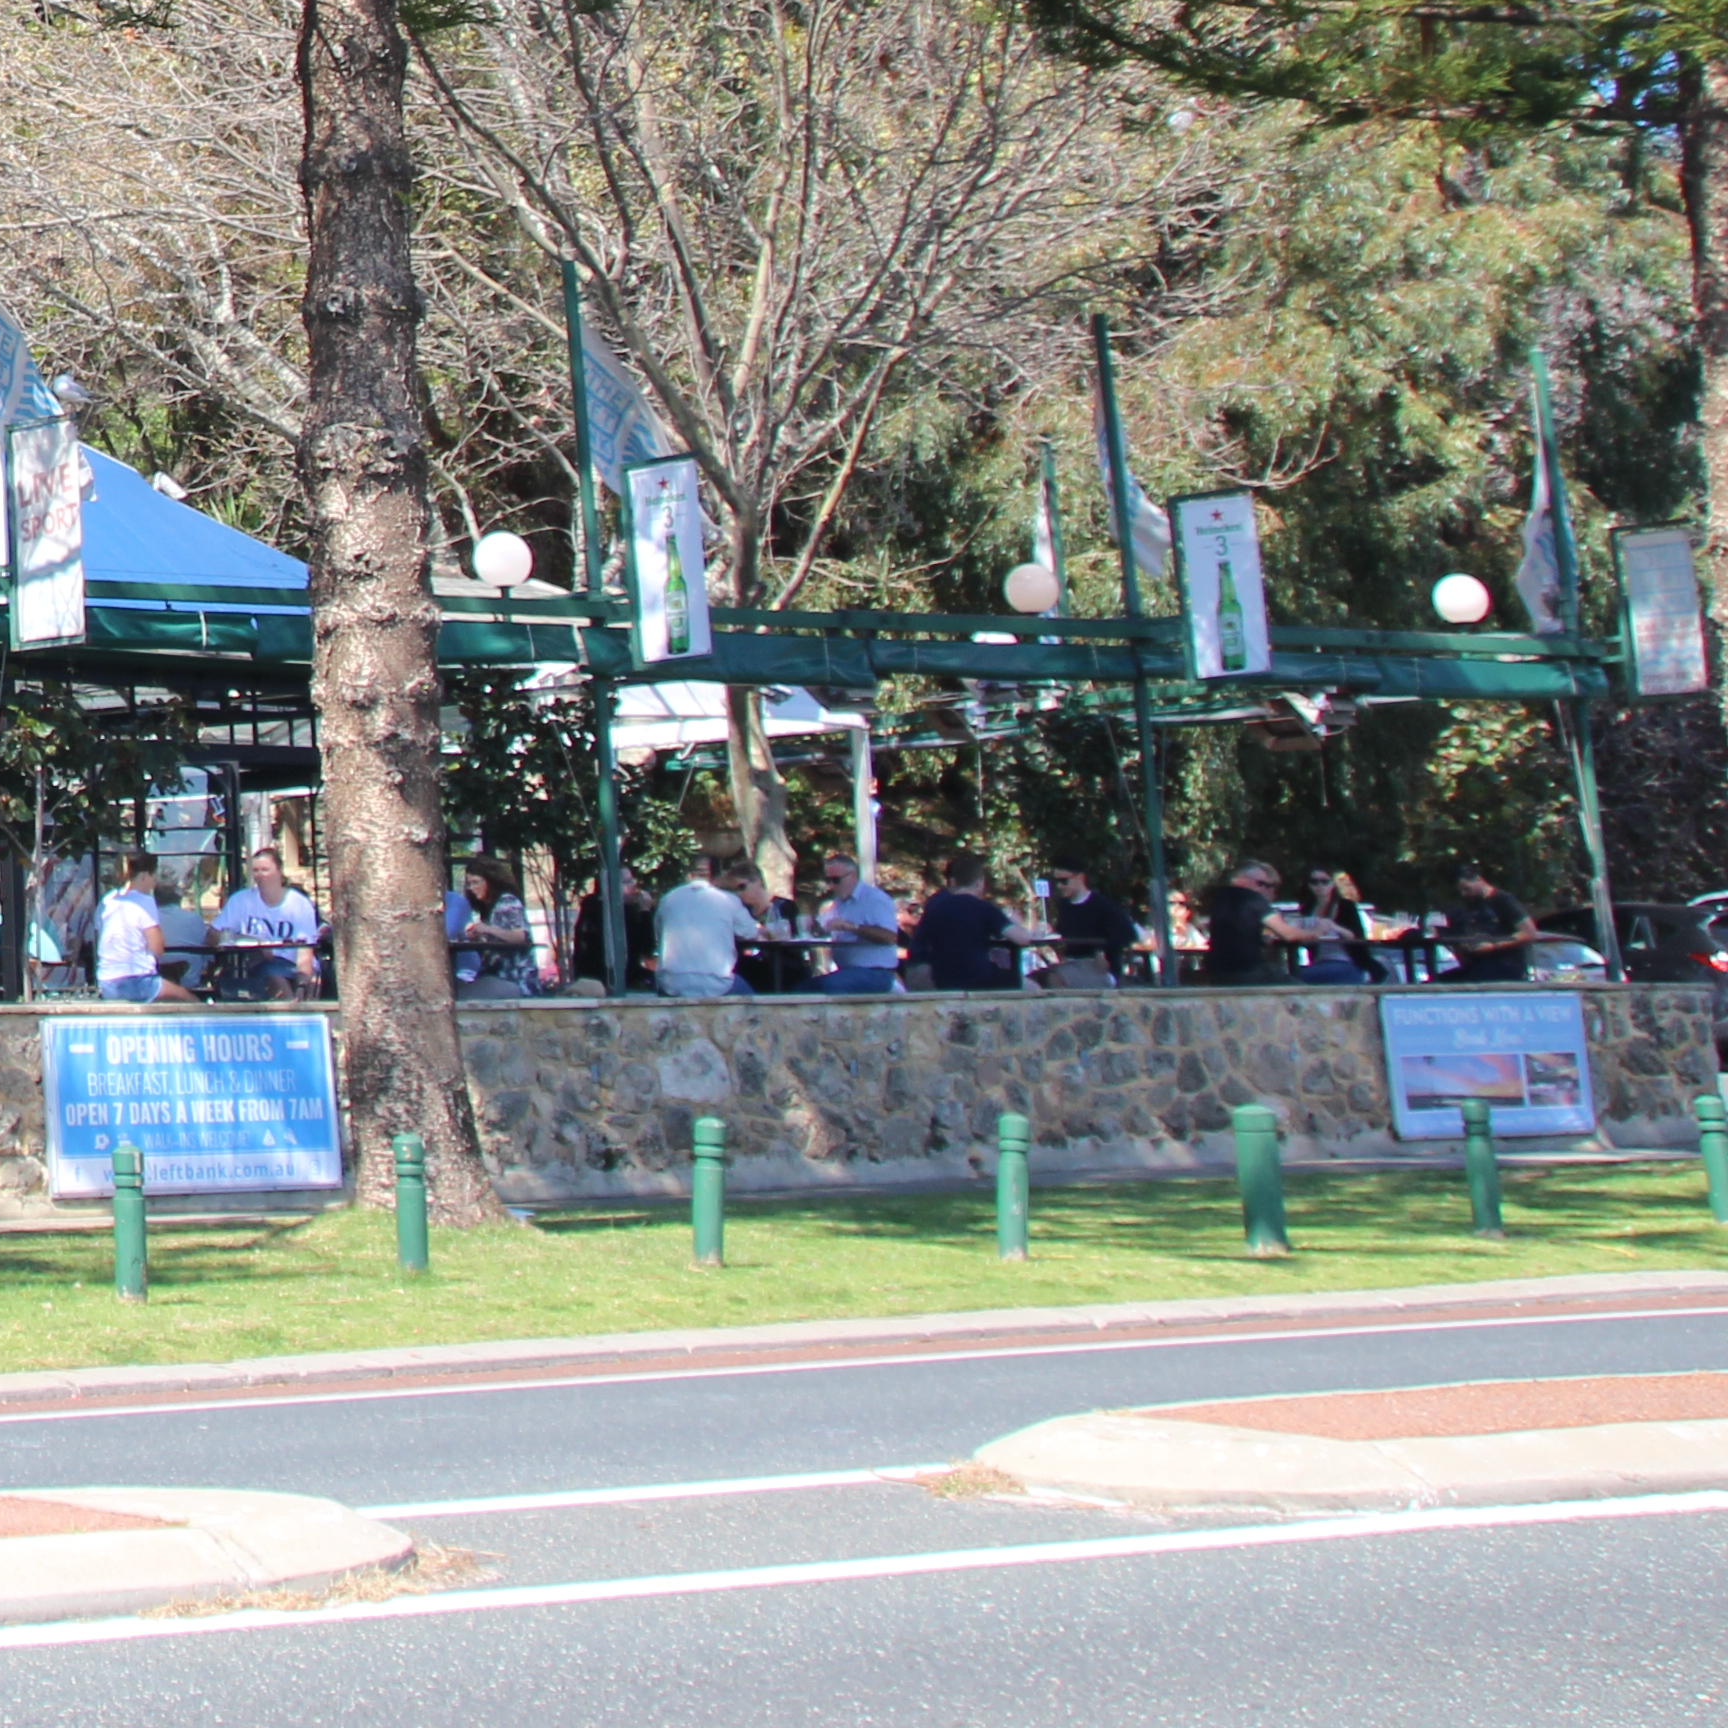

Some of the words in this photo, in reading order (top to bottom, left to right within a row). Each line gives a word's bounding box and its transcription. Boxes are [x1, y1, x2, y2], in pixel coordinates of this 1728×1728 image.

[17, 461, 73, 508] LIVE
[21, 502, 78, 543] SPORT
[1215, 535, 1228, 557] 3
[1394, 1007, 1479, 1025] FUNCTIONS
[1482, 1005, 1520, 1023] WITH
[1525, 1006, 1535, 1022] A
[1535, 1005, 1571, 1022] VIEW
[106, 1035, 195, 1065] OPENING
[203, 1033, 274, 1062] HOURS
[87, 1071, 172, 1097] BREAKFAST,
[176, 1071, 224, 1095] LUNCH
[228, 1071, 241, 1094] &
[244, 1069, 296, 1093] DINNER
[66, 1102, 108, 1126] OPEN
[113, 1101, 124, 1125] 7
[130, 1100, 171, 1125] DAYS
[176, 1099, 187, 1124] A
[191, 1099, 235, 1123] WEEK
[238, 1098, 284, 1122] FROM
[104, 1162, 294, 1182] w.leftbank.com.au
